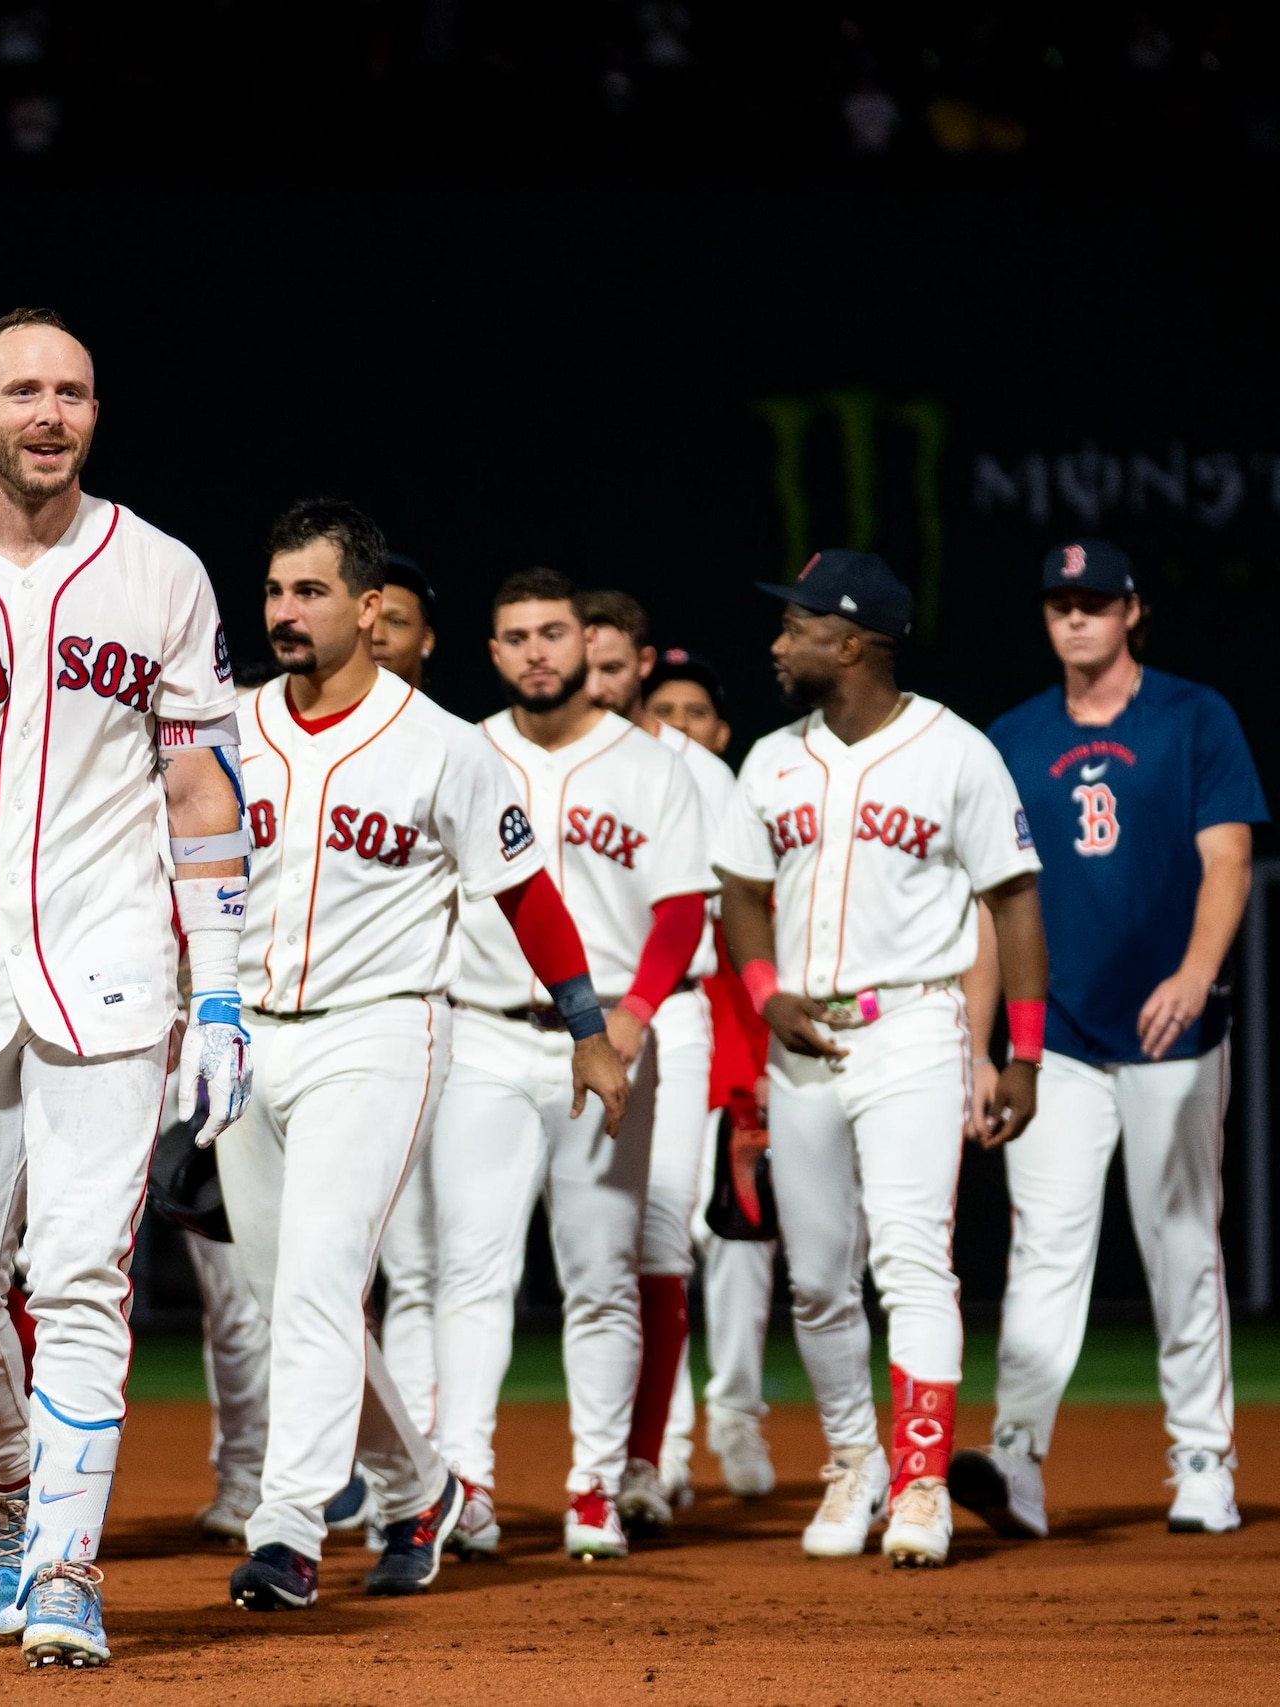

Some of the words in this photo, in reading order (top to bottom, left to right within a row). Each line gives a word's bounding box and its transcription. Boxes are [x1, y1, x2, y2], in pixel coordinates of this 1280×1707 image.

[57, 635, 161, 713] SOX
[326, 805, 419, 866] SOX
[565, 806, 649, 869] SOX
[856, 801, 941, 859] SOX
[1072, 783, 1120, 856] B
[221, 903, 244, 916] 10
